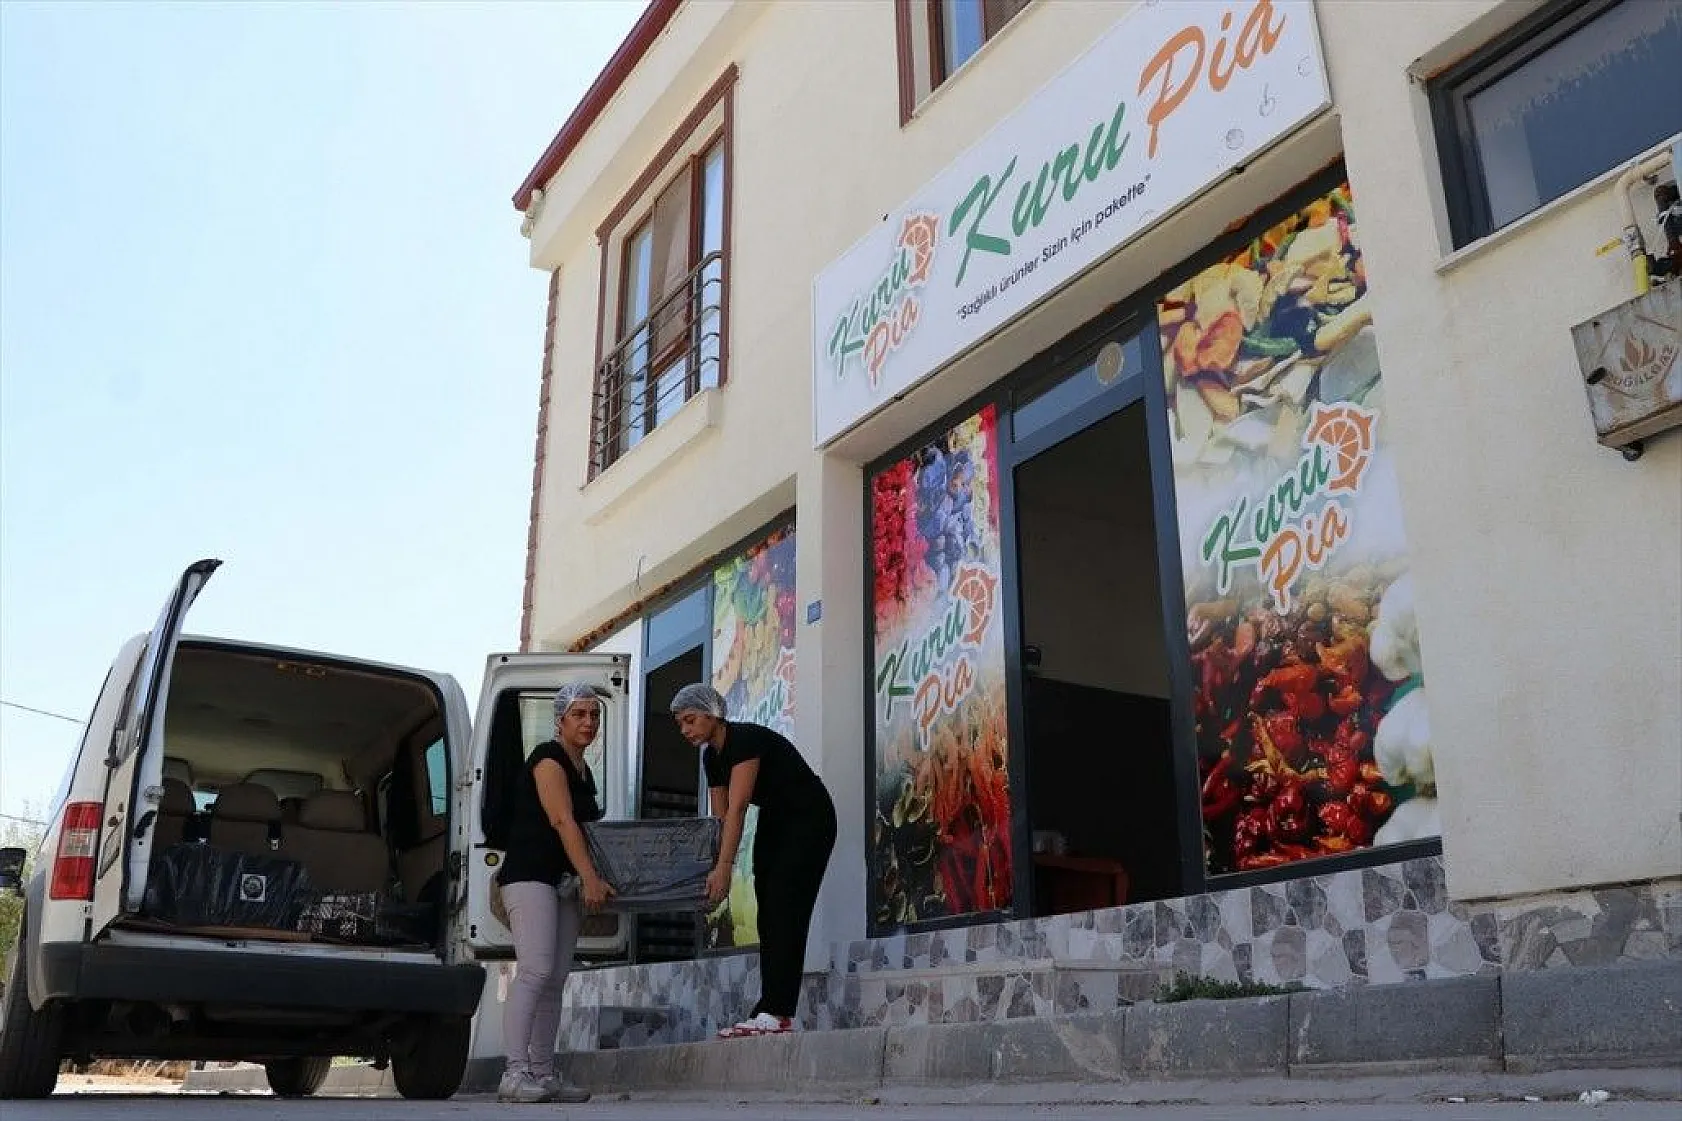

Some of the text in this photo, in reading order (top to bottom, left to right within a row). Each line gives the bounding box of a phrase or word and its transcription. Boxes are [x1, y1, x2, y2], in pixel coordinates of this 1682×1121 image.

[949, 0, 1286, 287] Kuru Pia
[1042, 236, 1068, 262] Sizin
[830, 248, 910, 376] Kuru
[865, 297, 918, 387] Pia
[1203, 445, 1331, 588] Kuru
[1261, 506, 1347, 607] Pia
[878, 600, 967, 720] Kuru
[914, 657, 973, 746] Pia
